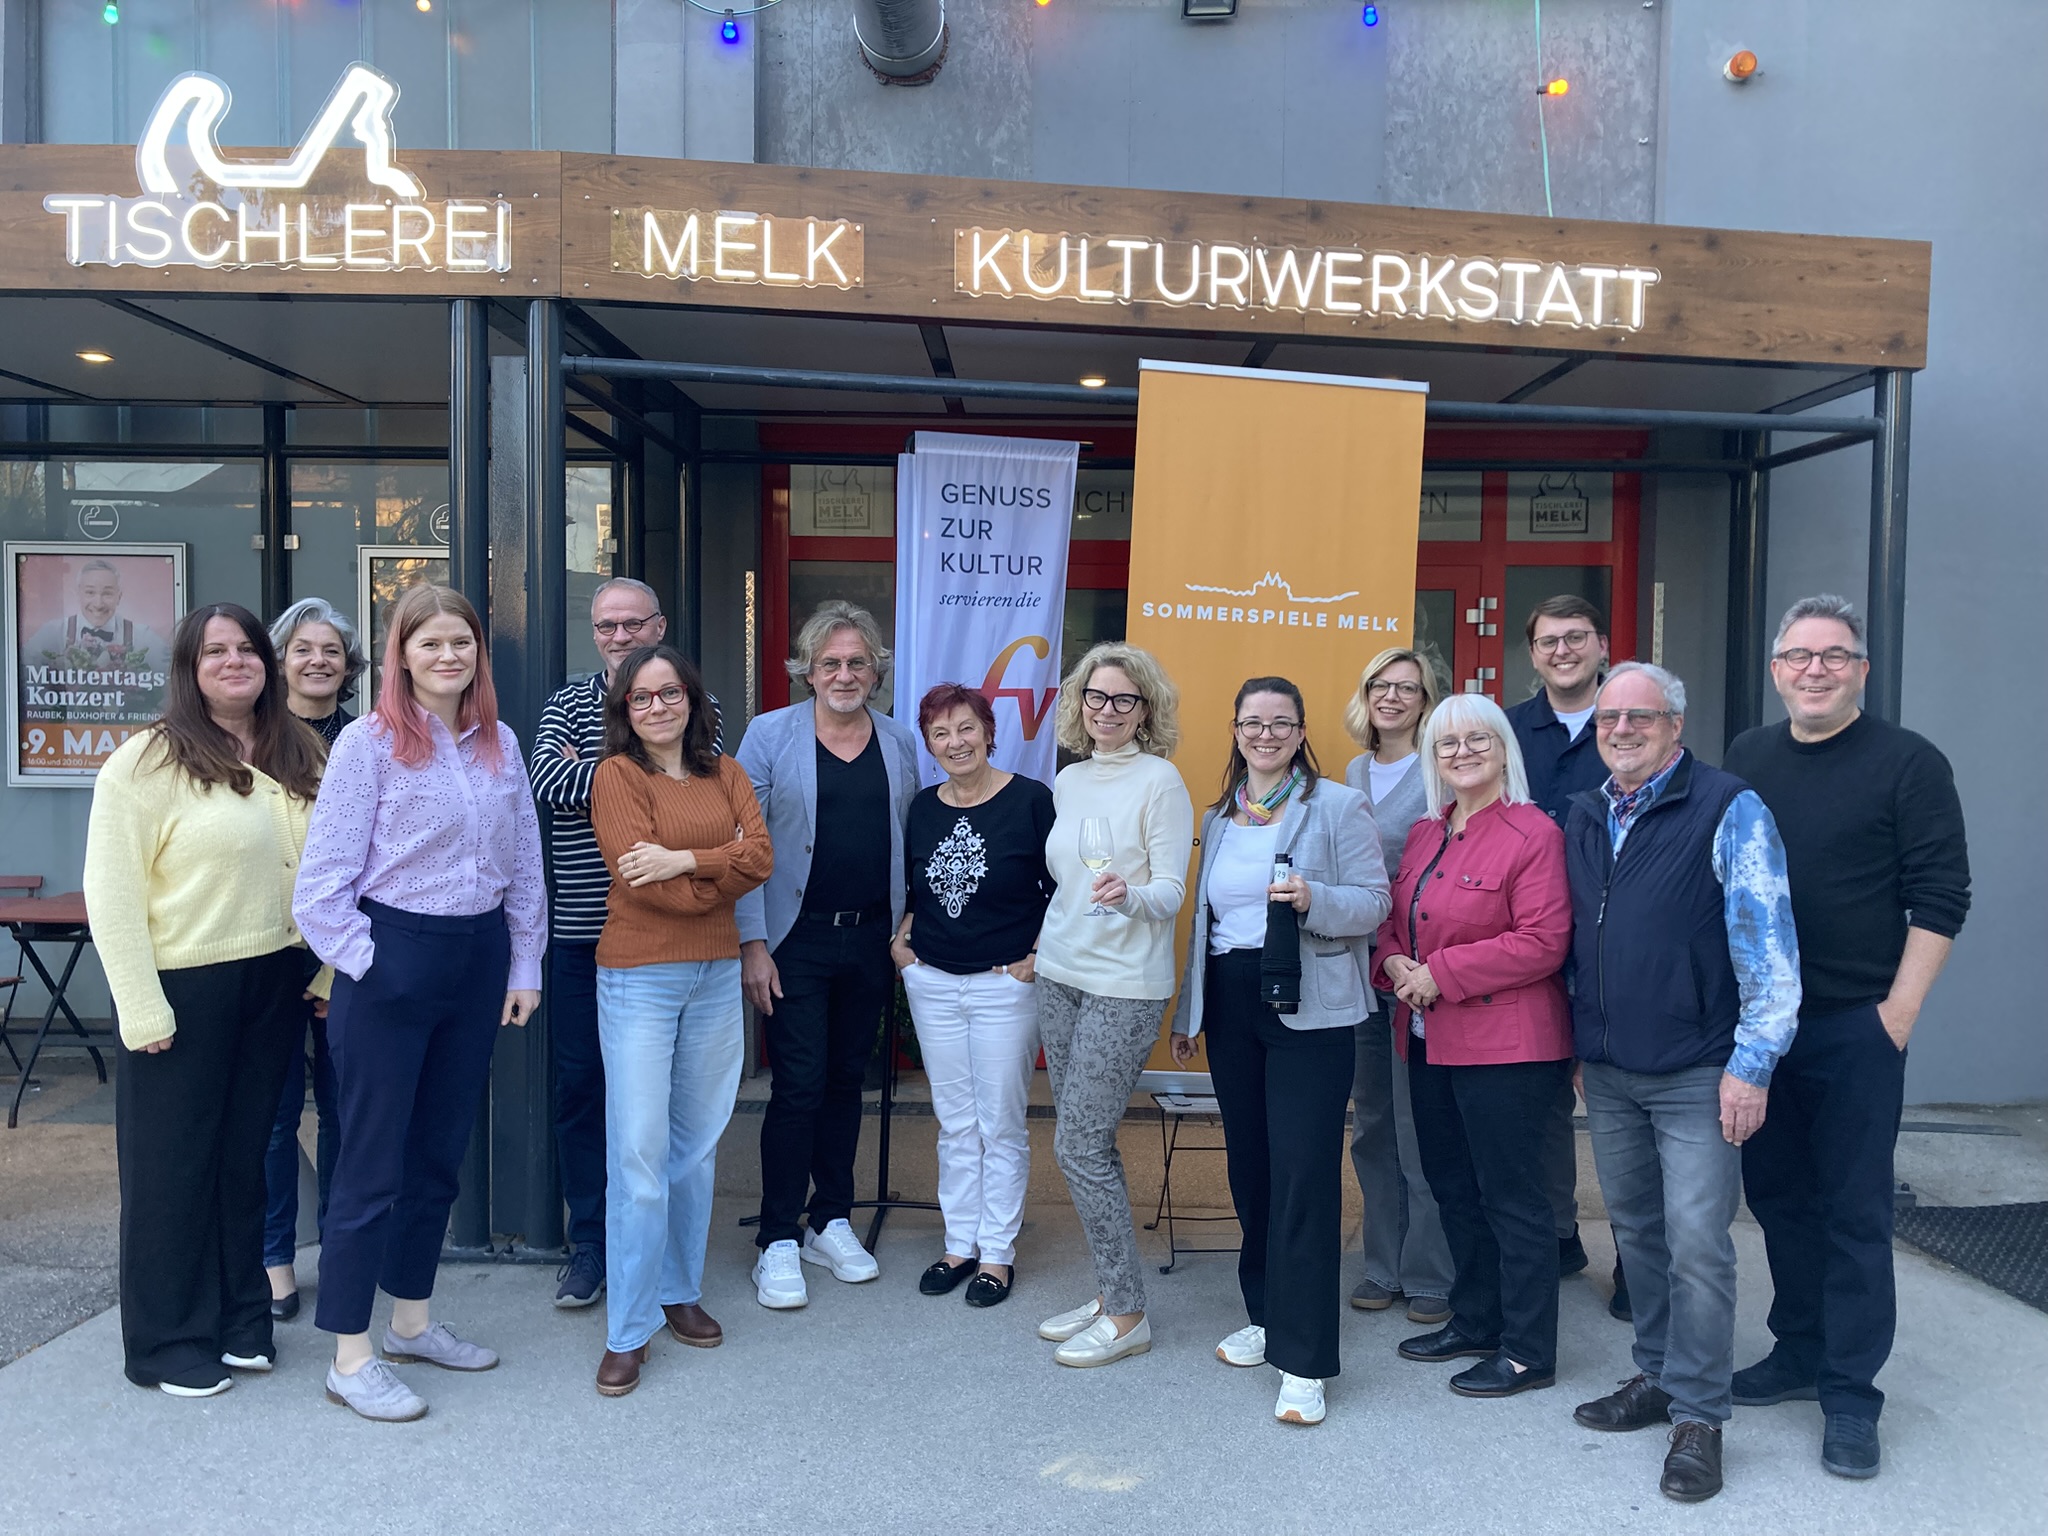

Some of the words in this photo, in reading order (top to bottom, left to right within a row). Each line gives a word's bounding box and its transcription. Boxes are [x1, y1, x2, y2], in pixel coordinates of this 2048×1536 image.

[47, 199, 506, 267] TISCHLEREI
[642, 210, 848, 284] MELK
[971, 230, 1657, 328] KULTURWERKSTATT
[941, 483, 1051, 508] GENUSS
[1535, 501, 1582, 509] TISCHLEREI
[819, 505, 863, 517] MELK
[1536, 510, 1582, 522] MELK
[940, 517, 993, 540] ZUR
[941, 552, 1043, 576] KULTUR
[939, 591, 1012, 607] servieren
[1015, 592, 1041, 608] die
[1142, 602, 1328, 628] SOMMERSPIELE
[1338, 614, 1399, 632] MELK
[26, 686, 125, 707] Konzert
[26, 710, 64, 720] RAUBEK,
[67, 712, 115, 721] BUXHOFER
[118, 712, 125, 721] &
[28, 728, 55, 755] 9.
